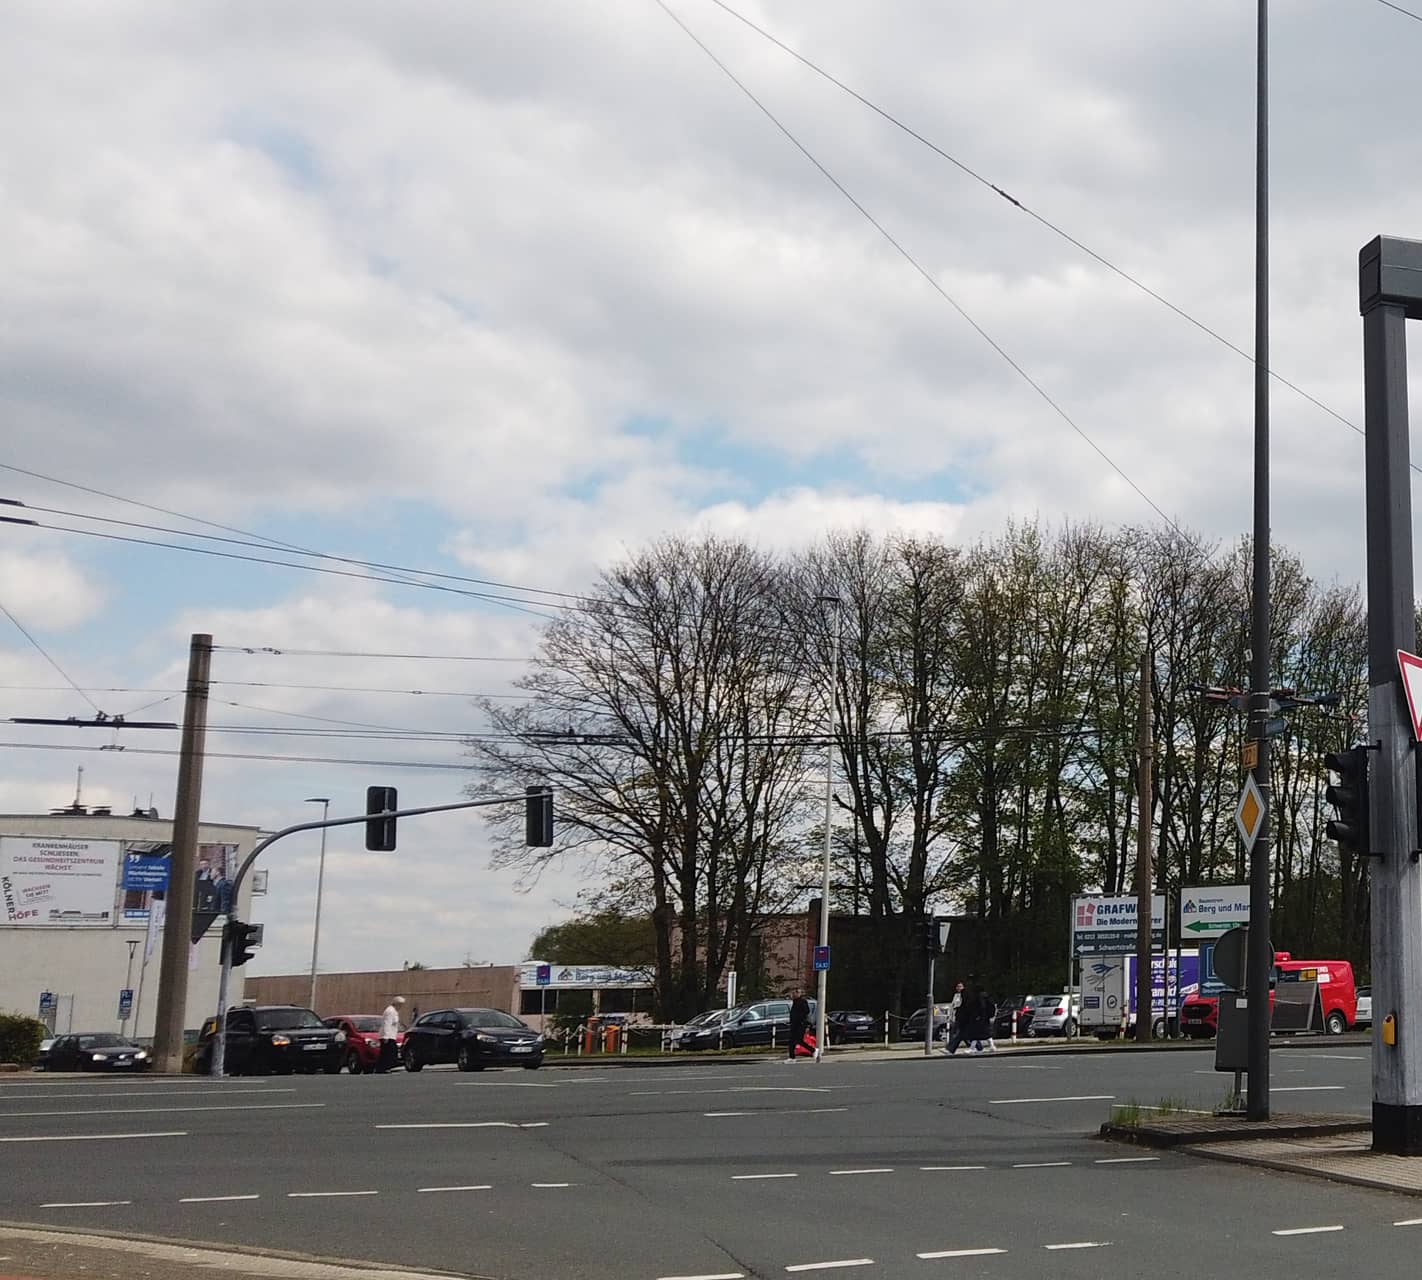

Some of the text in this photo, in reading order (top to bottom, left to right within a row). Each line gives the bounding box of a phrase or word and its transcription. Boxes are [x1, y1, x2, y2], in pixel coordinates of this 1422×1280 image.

[1, 876, 16, 914] KÖLNER
[1097, 903, 1137, 915] GRAFW
[1198, 904, 1216, 915] Berg
[1234, 902, 1249, 911] Mar
[9, 909, 39, 921] HÖFE
